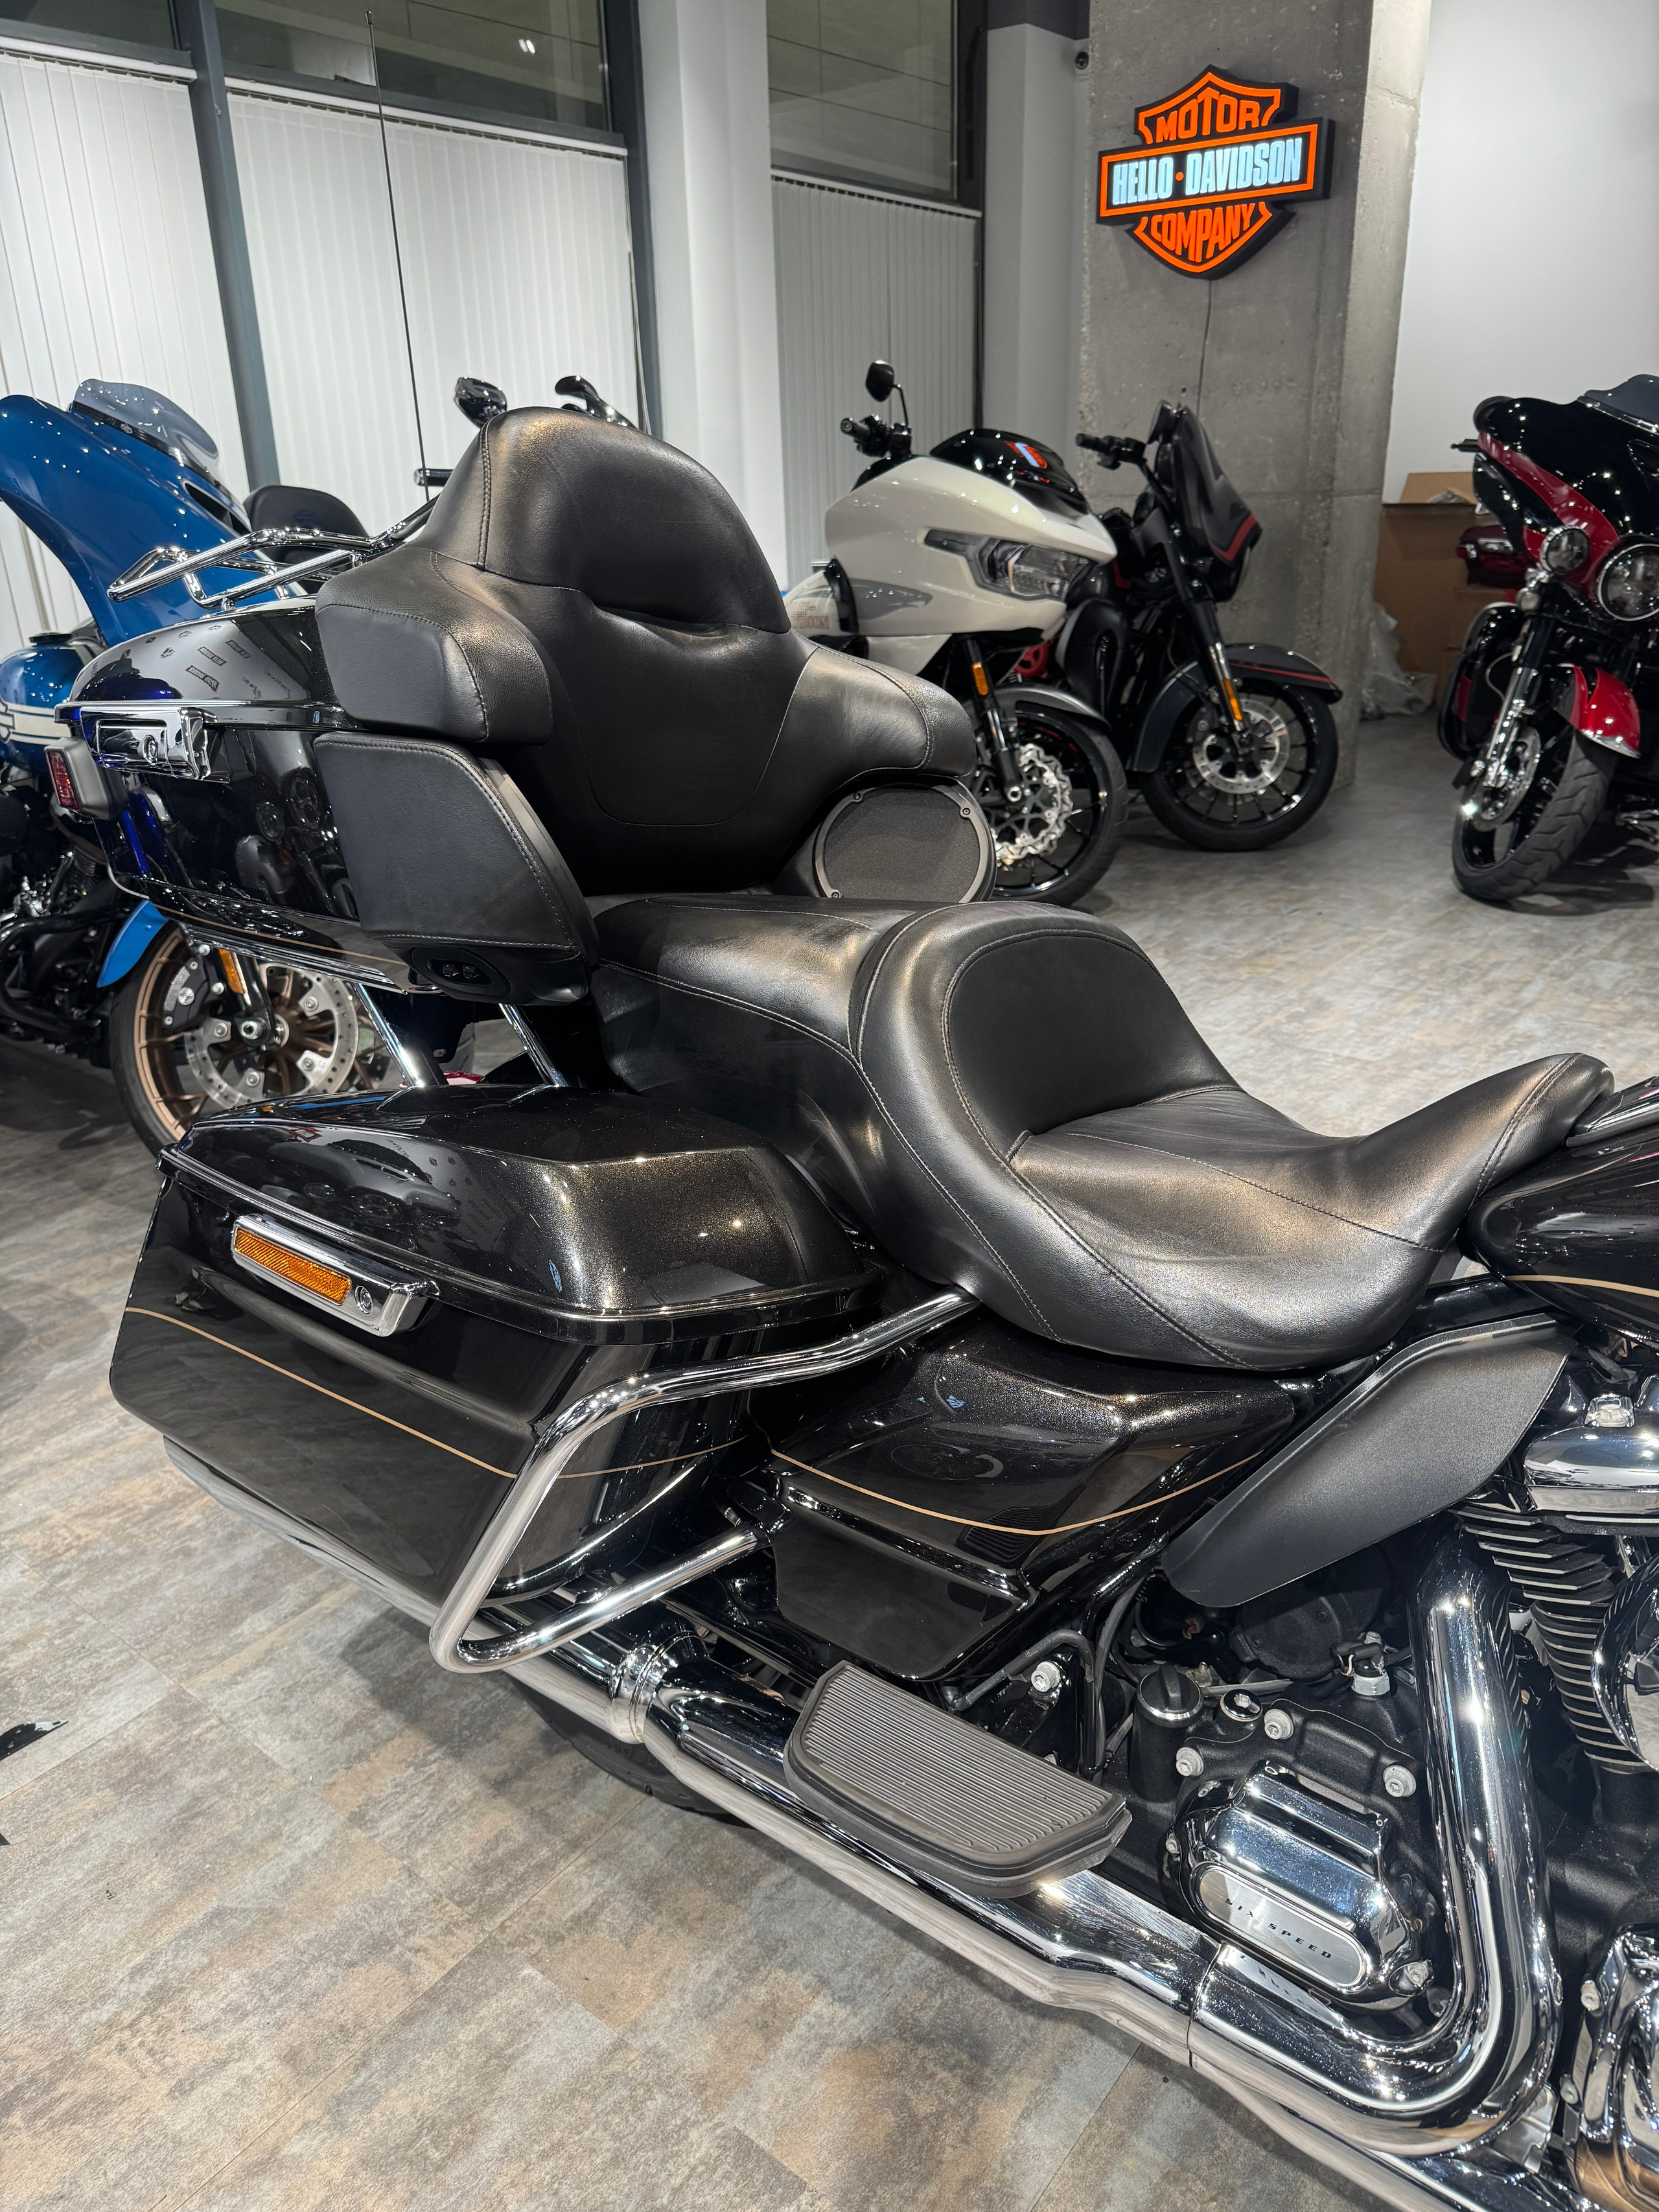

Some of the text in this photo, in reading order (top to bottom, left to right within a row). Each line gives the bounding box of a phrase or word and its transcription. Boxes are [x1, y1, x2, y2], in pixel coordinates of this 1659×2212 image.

[1155, 87, 1260, 143] MOTOR
[1112, 137, 1303, 205] HELLO DAVIDSON
[1150, 202, 1256, 262] COMPANY
[1224, 1898, 1332, 1959] SIX SPEED
